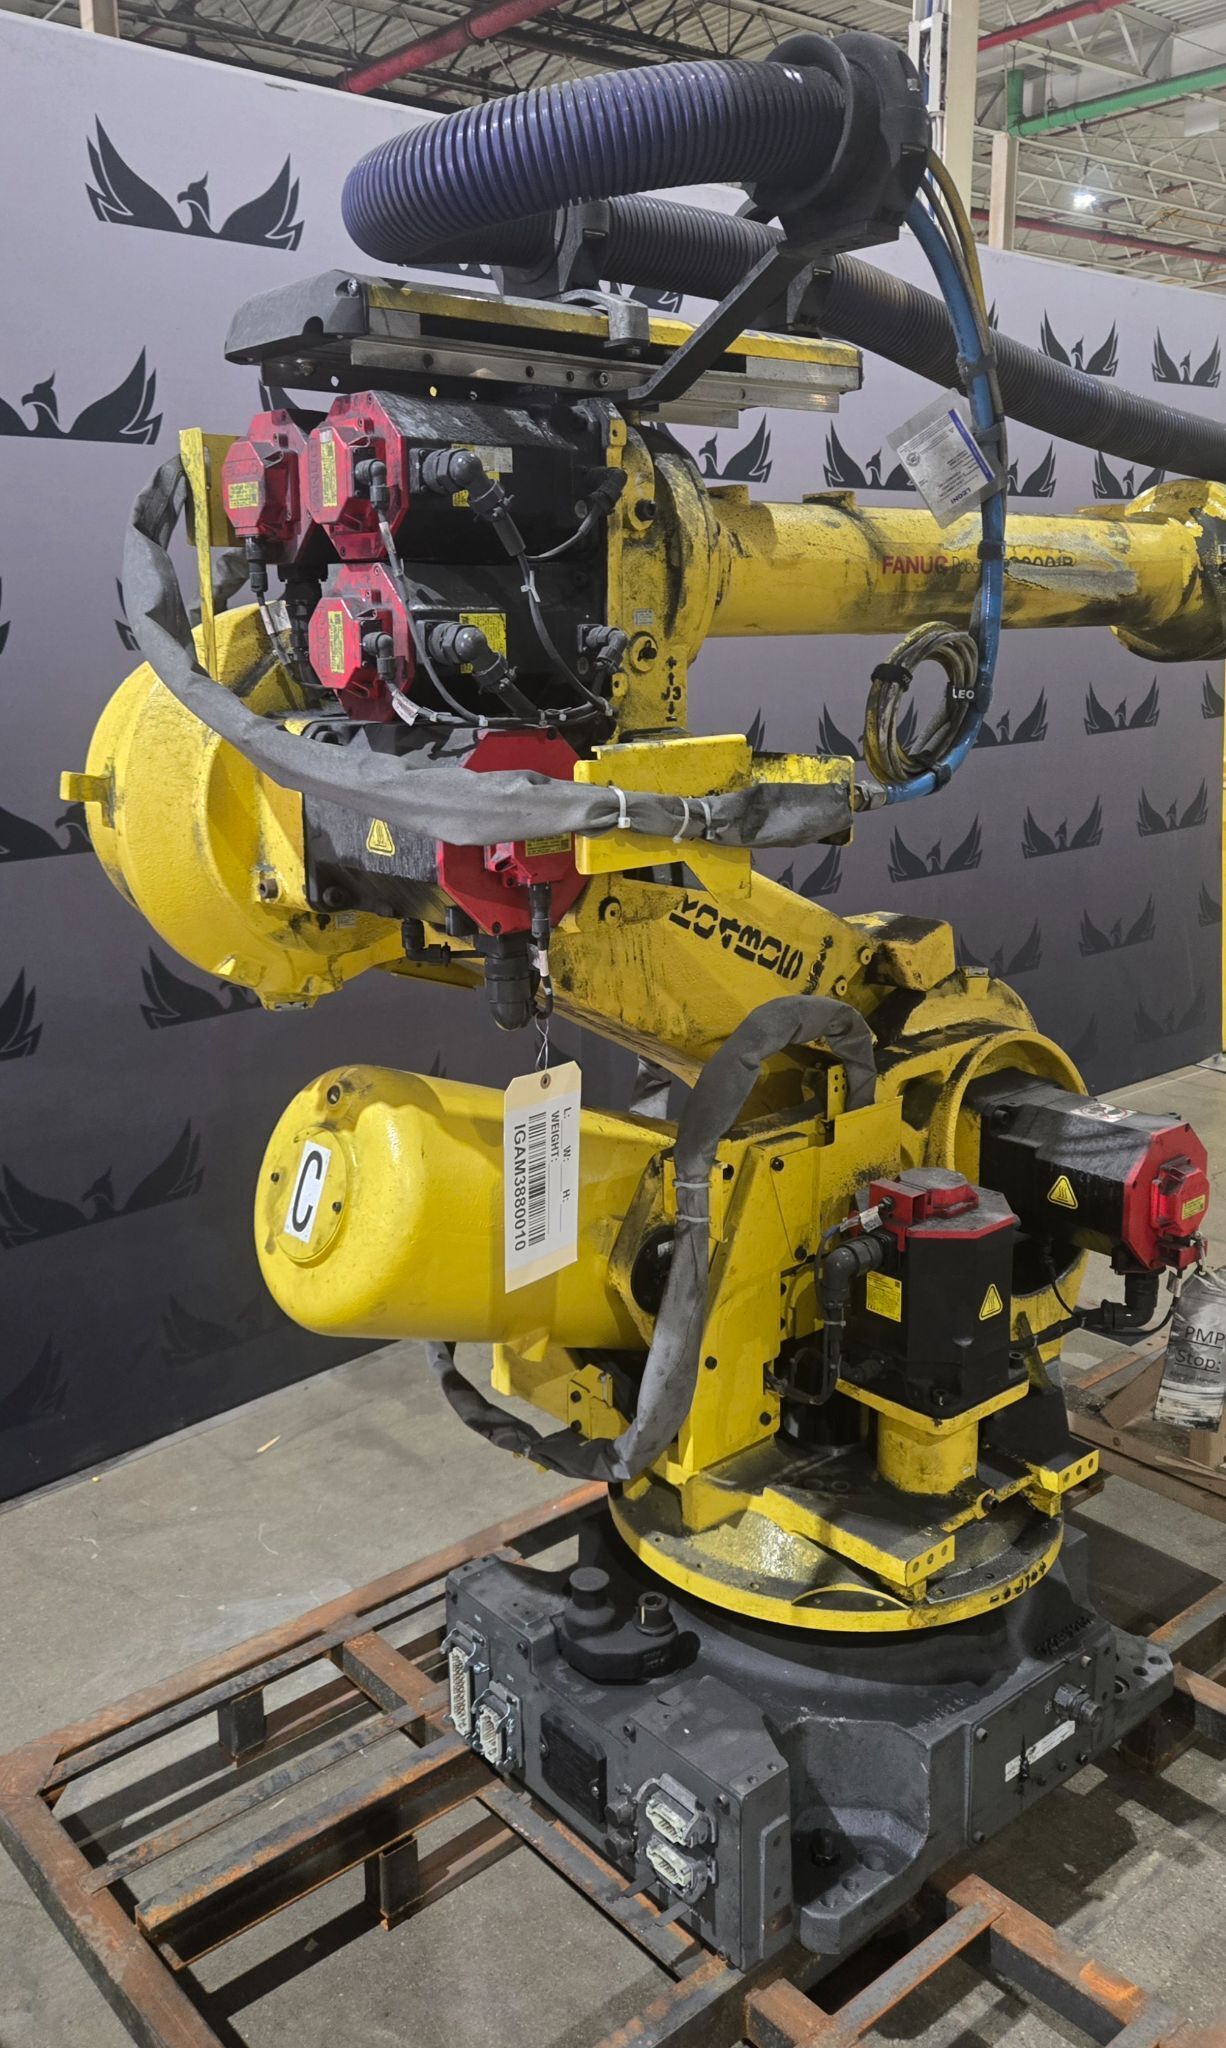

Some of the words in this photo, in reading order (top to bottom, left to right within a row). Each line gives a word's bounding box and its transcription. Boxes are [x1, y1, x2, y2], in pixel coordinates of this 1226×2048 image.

[882, 555, 949, 574] FANUC
[551, 1109, 560, 1163] WEIGHT:
[514, 1123, 526, 1252] IGAM3880010
[1185, 1326, 1226, 1345] PMP
[1174, 1350, 1222, 1371] Stop:
